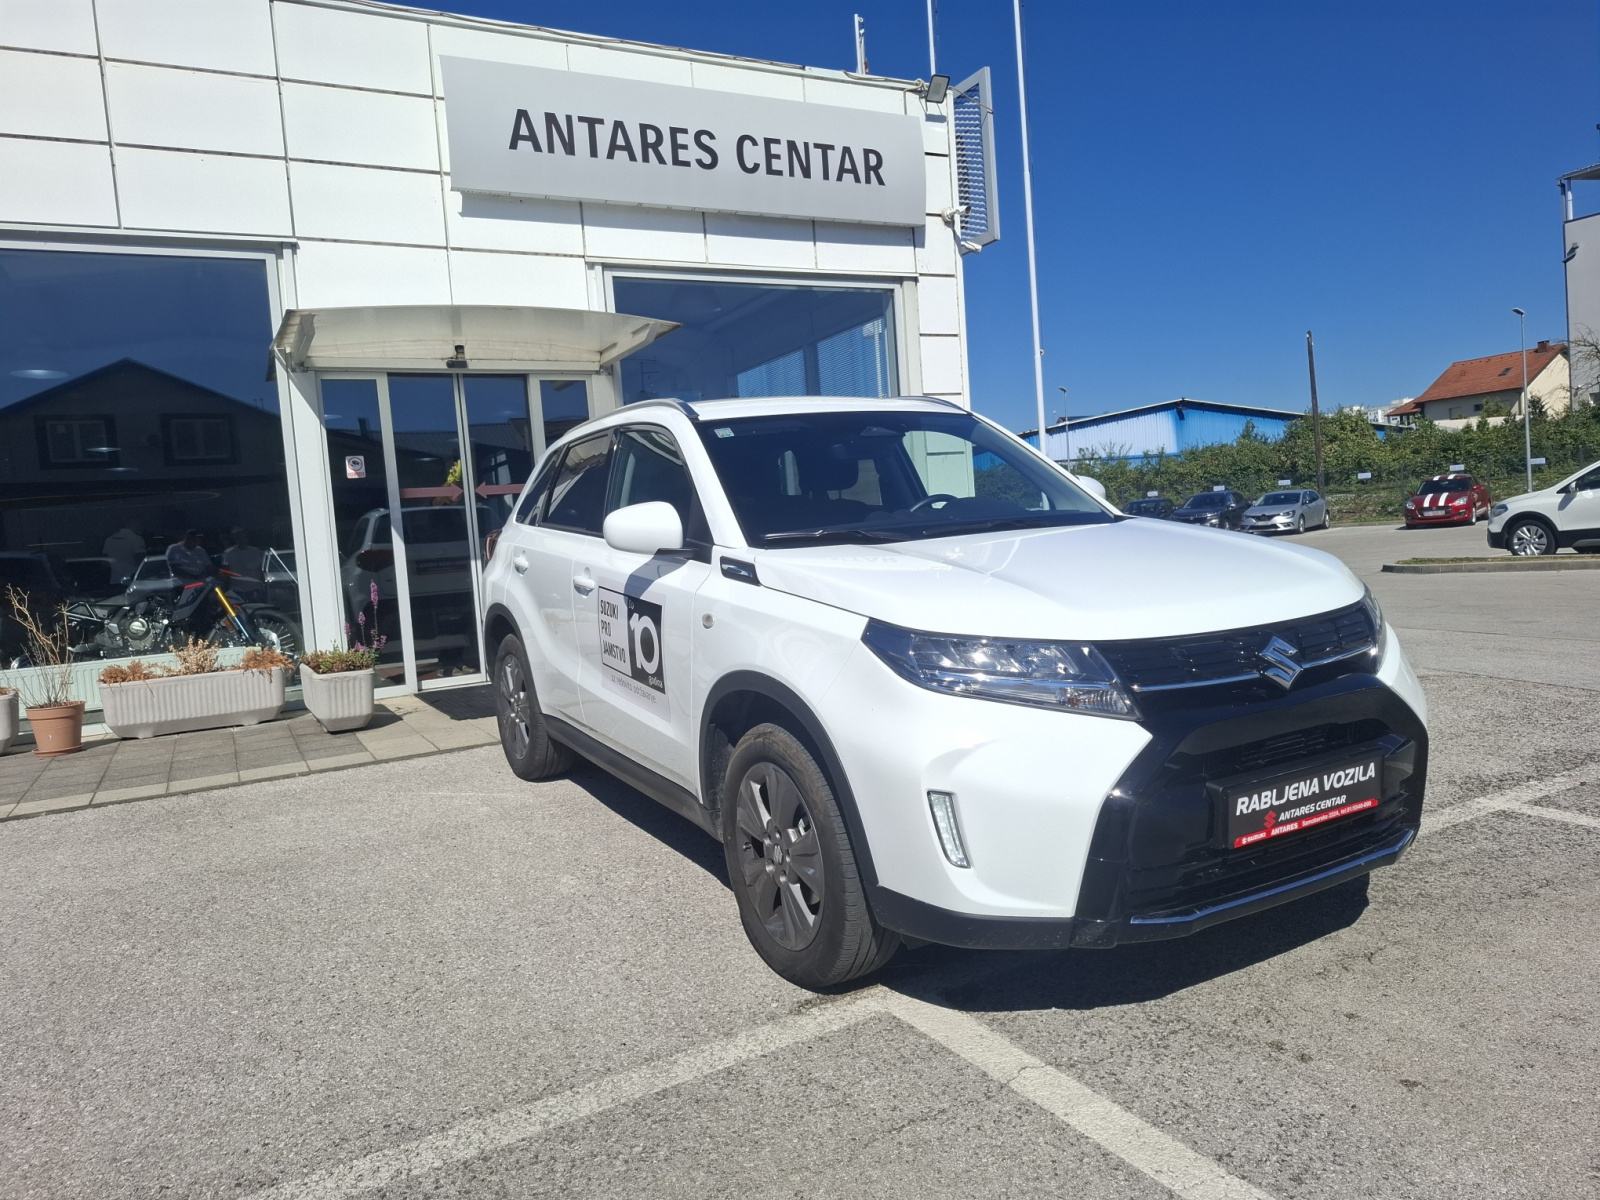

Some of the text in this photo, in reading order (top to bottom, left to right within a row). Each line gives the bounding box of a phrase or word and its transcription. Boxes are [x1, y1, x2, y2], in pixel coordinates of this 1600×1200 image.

[508, 108, 886, 187] ANTARES CENTAR
[600, 600, 618, 620] SUZUKI
[601, 620, 612, 637] PRO
[603, 640, 626, 663] JAMSTVO
[630, 612, 660, 675] 10
[1236, 762, 1376, 816] RABLJENA VOZILA
[1278, 795, 1347, 822] ANTARES CENTAR
[1270, 822, 1298, 836] ANTARES
